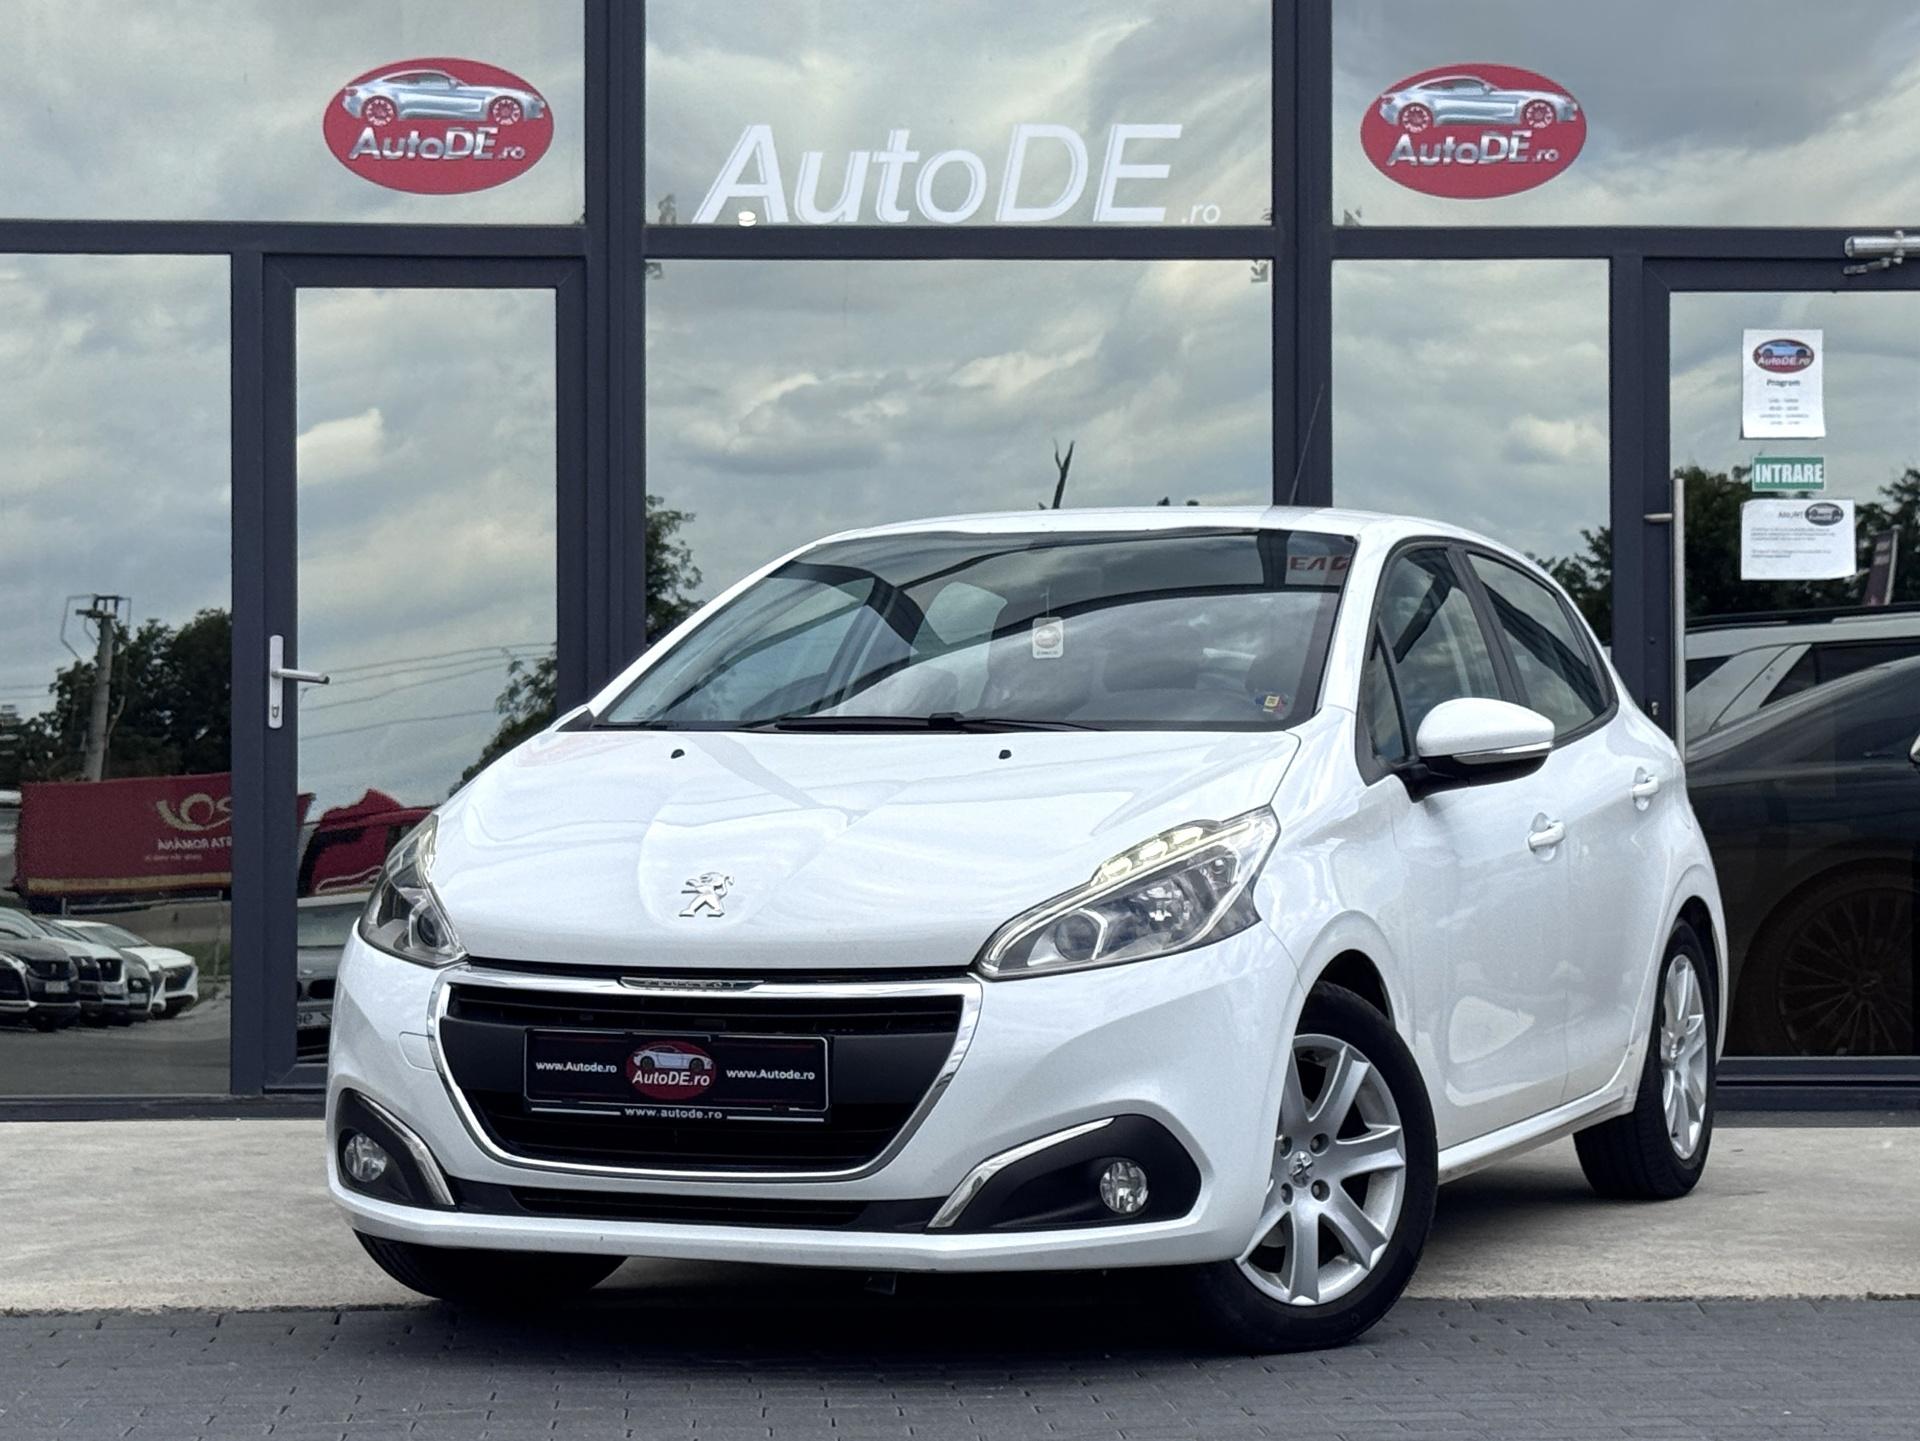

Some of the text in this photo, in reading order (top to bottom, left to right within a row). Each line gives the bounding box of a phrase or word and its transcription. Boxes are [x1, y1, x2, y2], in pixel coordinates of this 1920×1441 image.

[1754, 463, 1823, 483] INTRARE
[536, 1061, 617, 1073] www.Autode.ro
[632, 1070, 710, 1086] AutoDE.ro
[726, 1069, 815, 1080] www.Autode.ro
[624, 1107, 722, 1119] www.autode.ro
